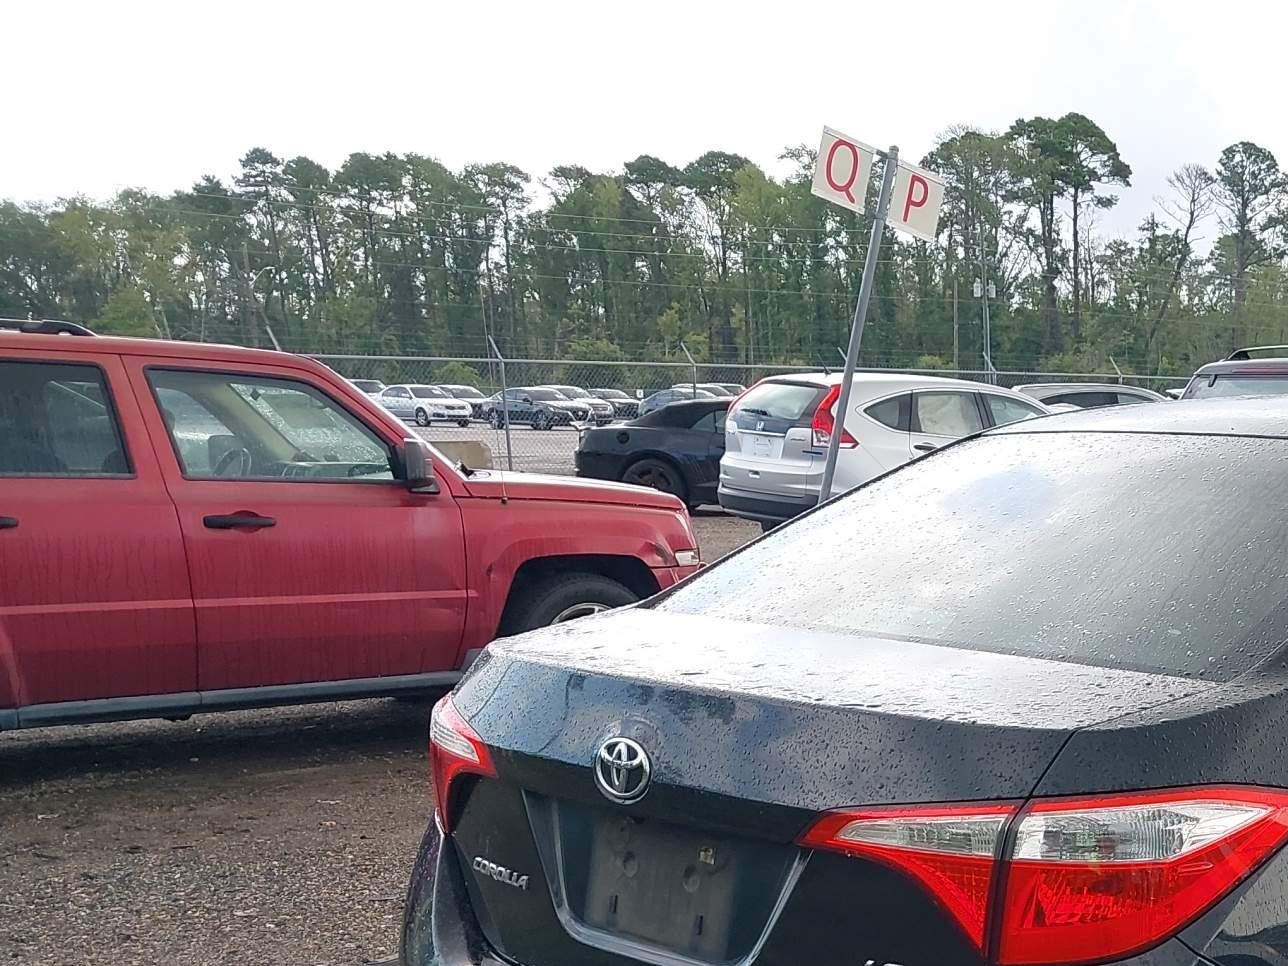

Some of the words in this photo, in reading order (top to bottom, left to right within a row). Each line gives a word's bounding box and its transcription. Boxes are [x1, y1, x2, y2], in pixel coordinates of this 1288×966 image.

[825, 138, 860, 205] Q
[902, 173, 930, 223] P
[472, 856, 529, 890] COROLLA
